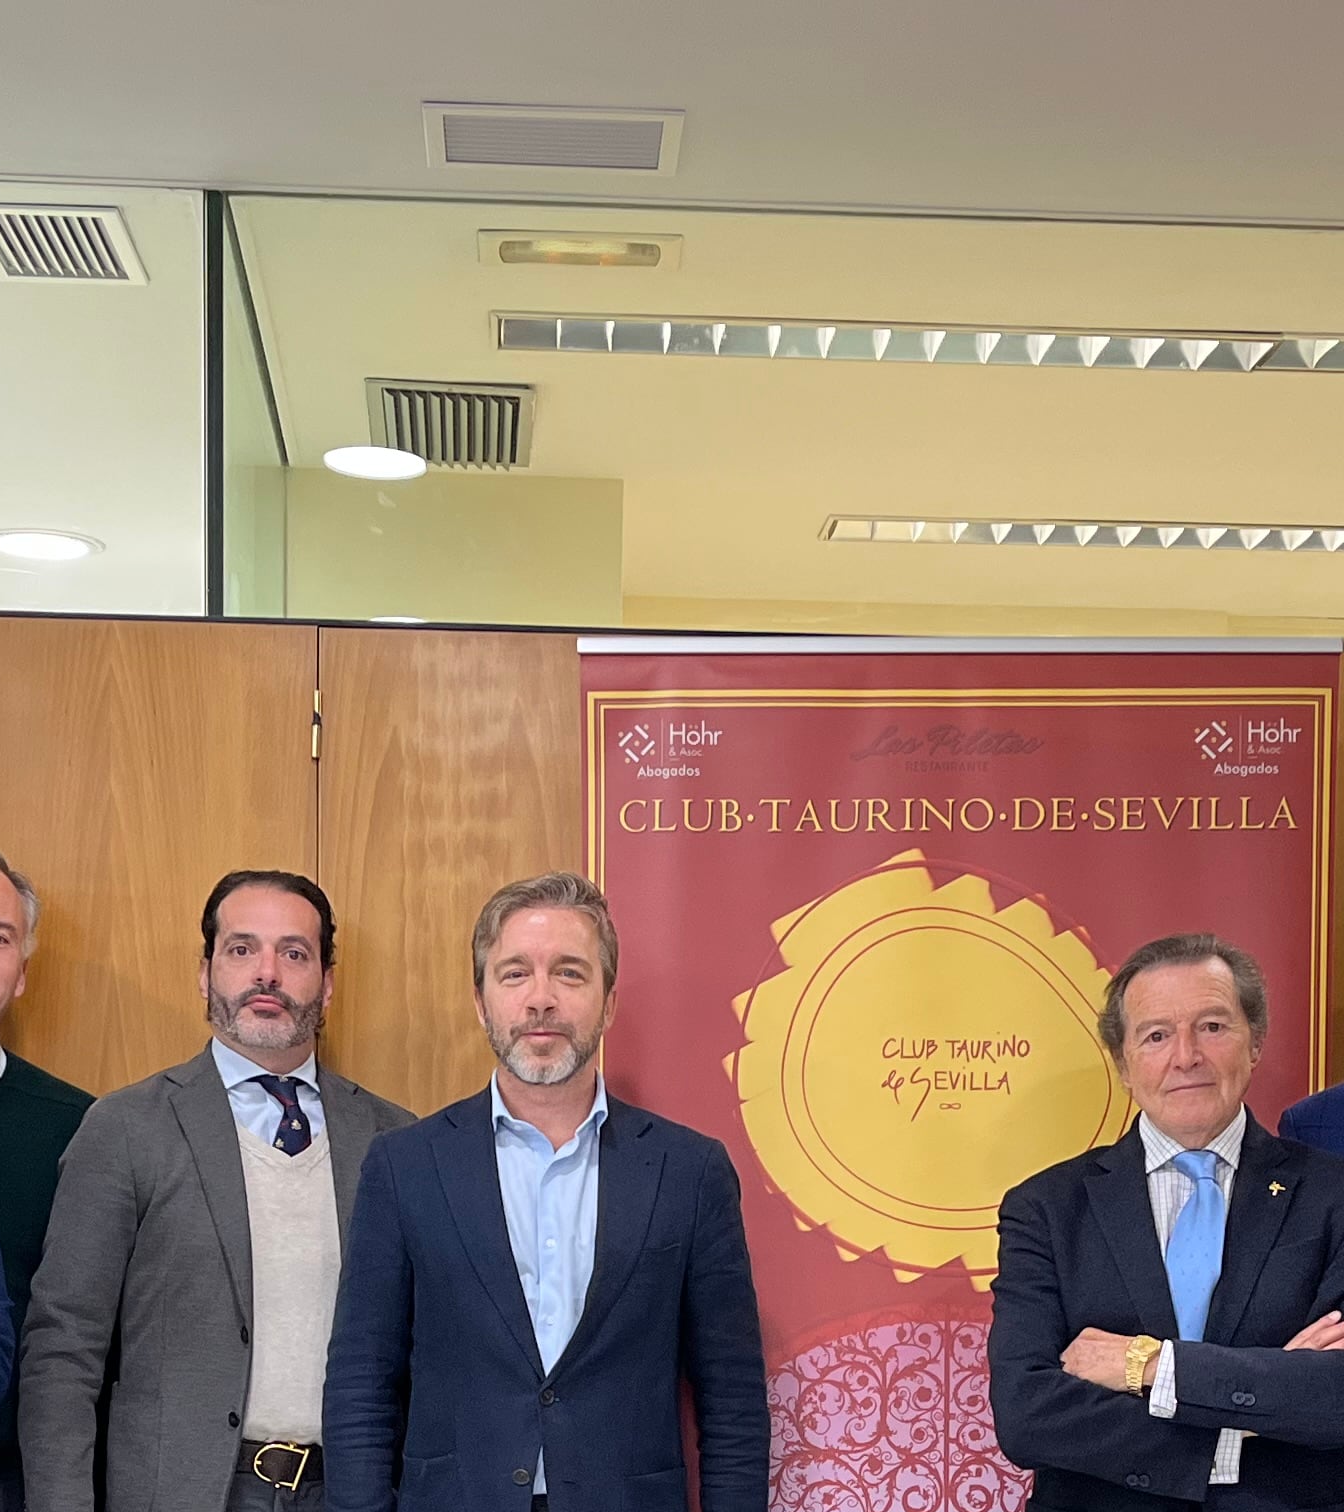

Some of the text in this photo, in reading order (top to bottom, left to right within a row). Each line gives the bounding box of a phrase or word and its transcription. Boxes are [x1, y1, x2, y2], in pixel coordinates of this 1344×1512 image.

[669, 720, 723, 745] Höhr
[927, 723, 1045, 757] Piletas
[1247, 717, 1302, 743] Höhr
[637, 764, 700, 779] Abogados
[905, 760, 989, 773] RESTAURANTE
[1214, 762, 1279, 777] Abogados
[882, 1037, 938, 1060] CLUB
